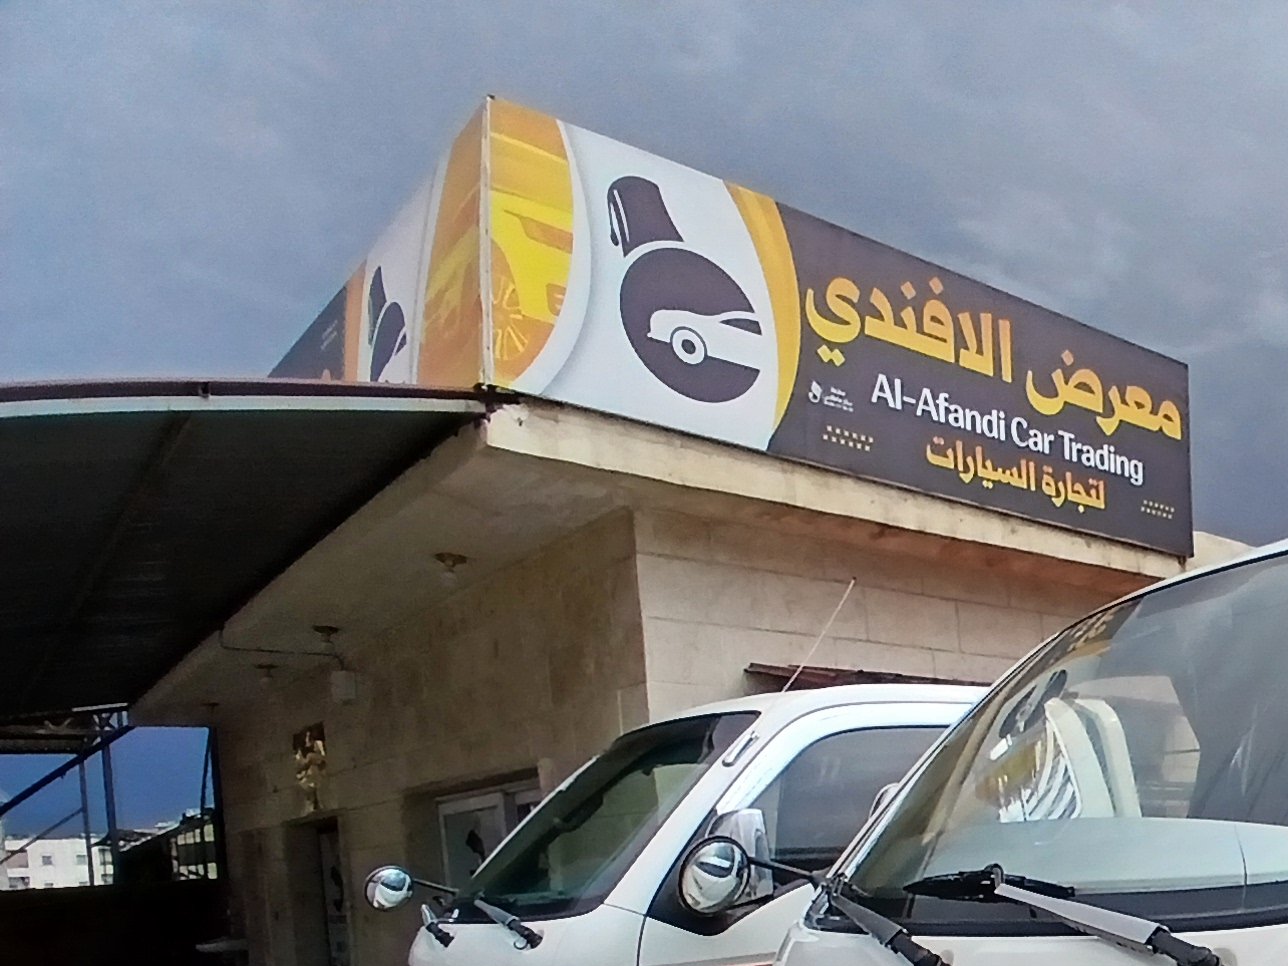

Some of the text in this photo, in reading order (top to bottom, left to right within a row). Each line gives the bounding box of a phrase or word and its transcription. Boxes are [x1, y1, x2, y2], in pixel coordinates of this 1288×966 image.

[806, 277, 1181, 440] معرض الافندي
[871, 374, 1006, 441] Al-Afandi
[1010, 416, 1055, 455] Car
[1058, 430, 1143, 486] Trading
[926, 436, 1105, 510] لتجارة السيارات
